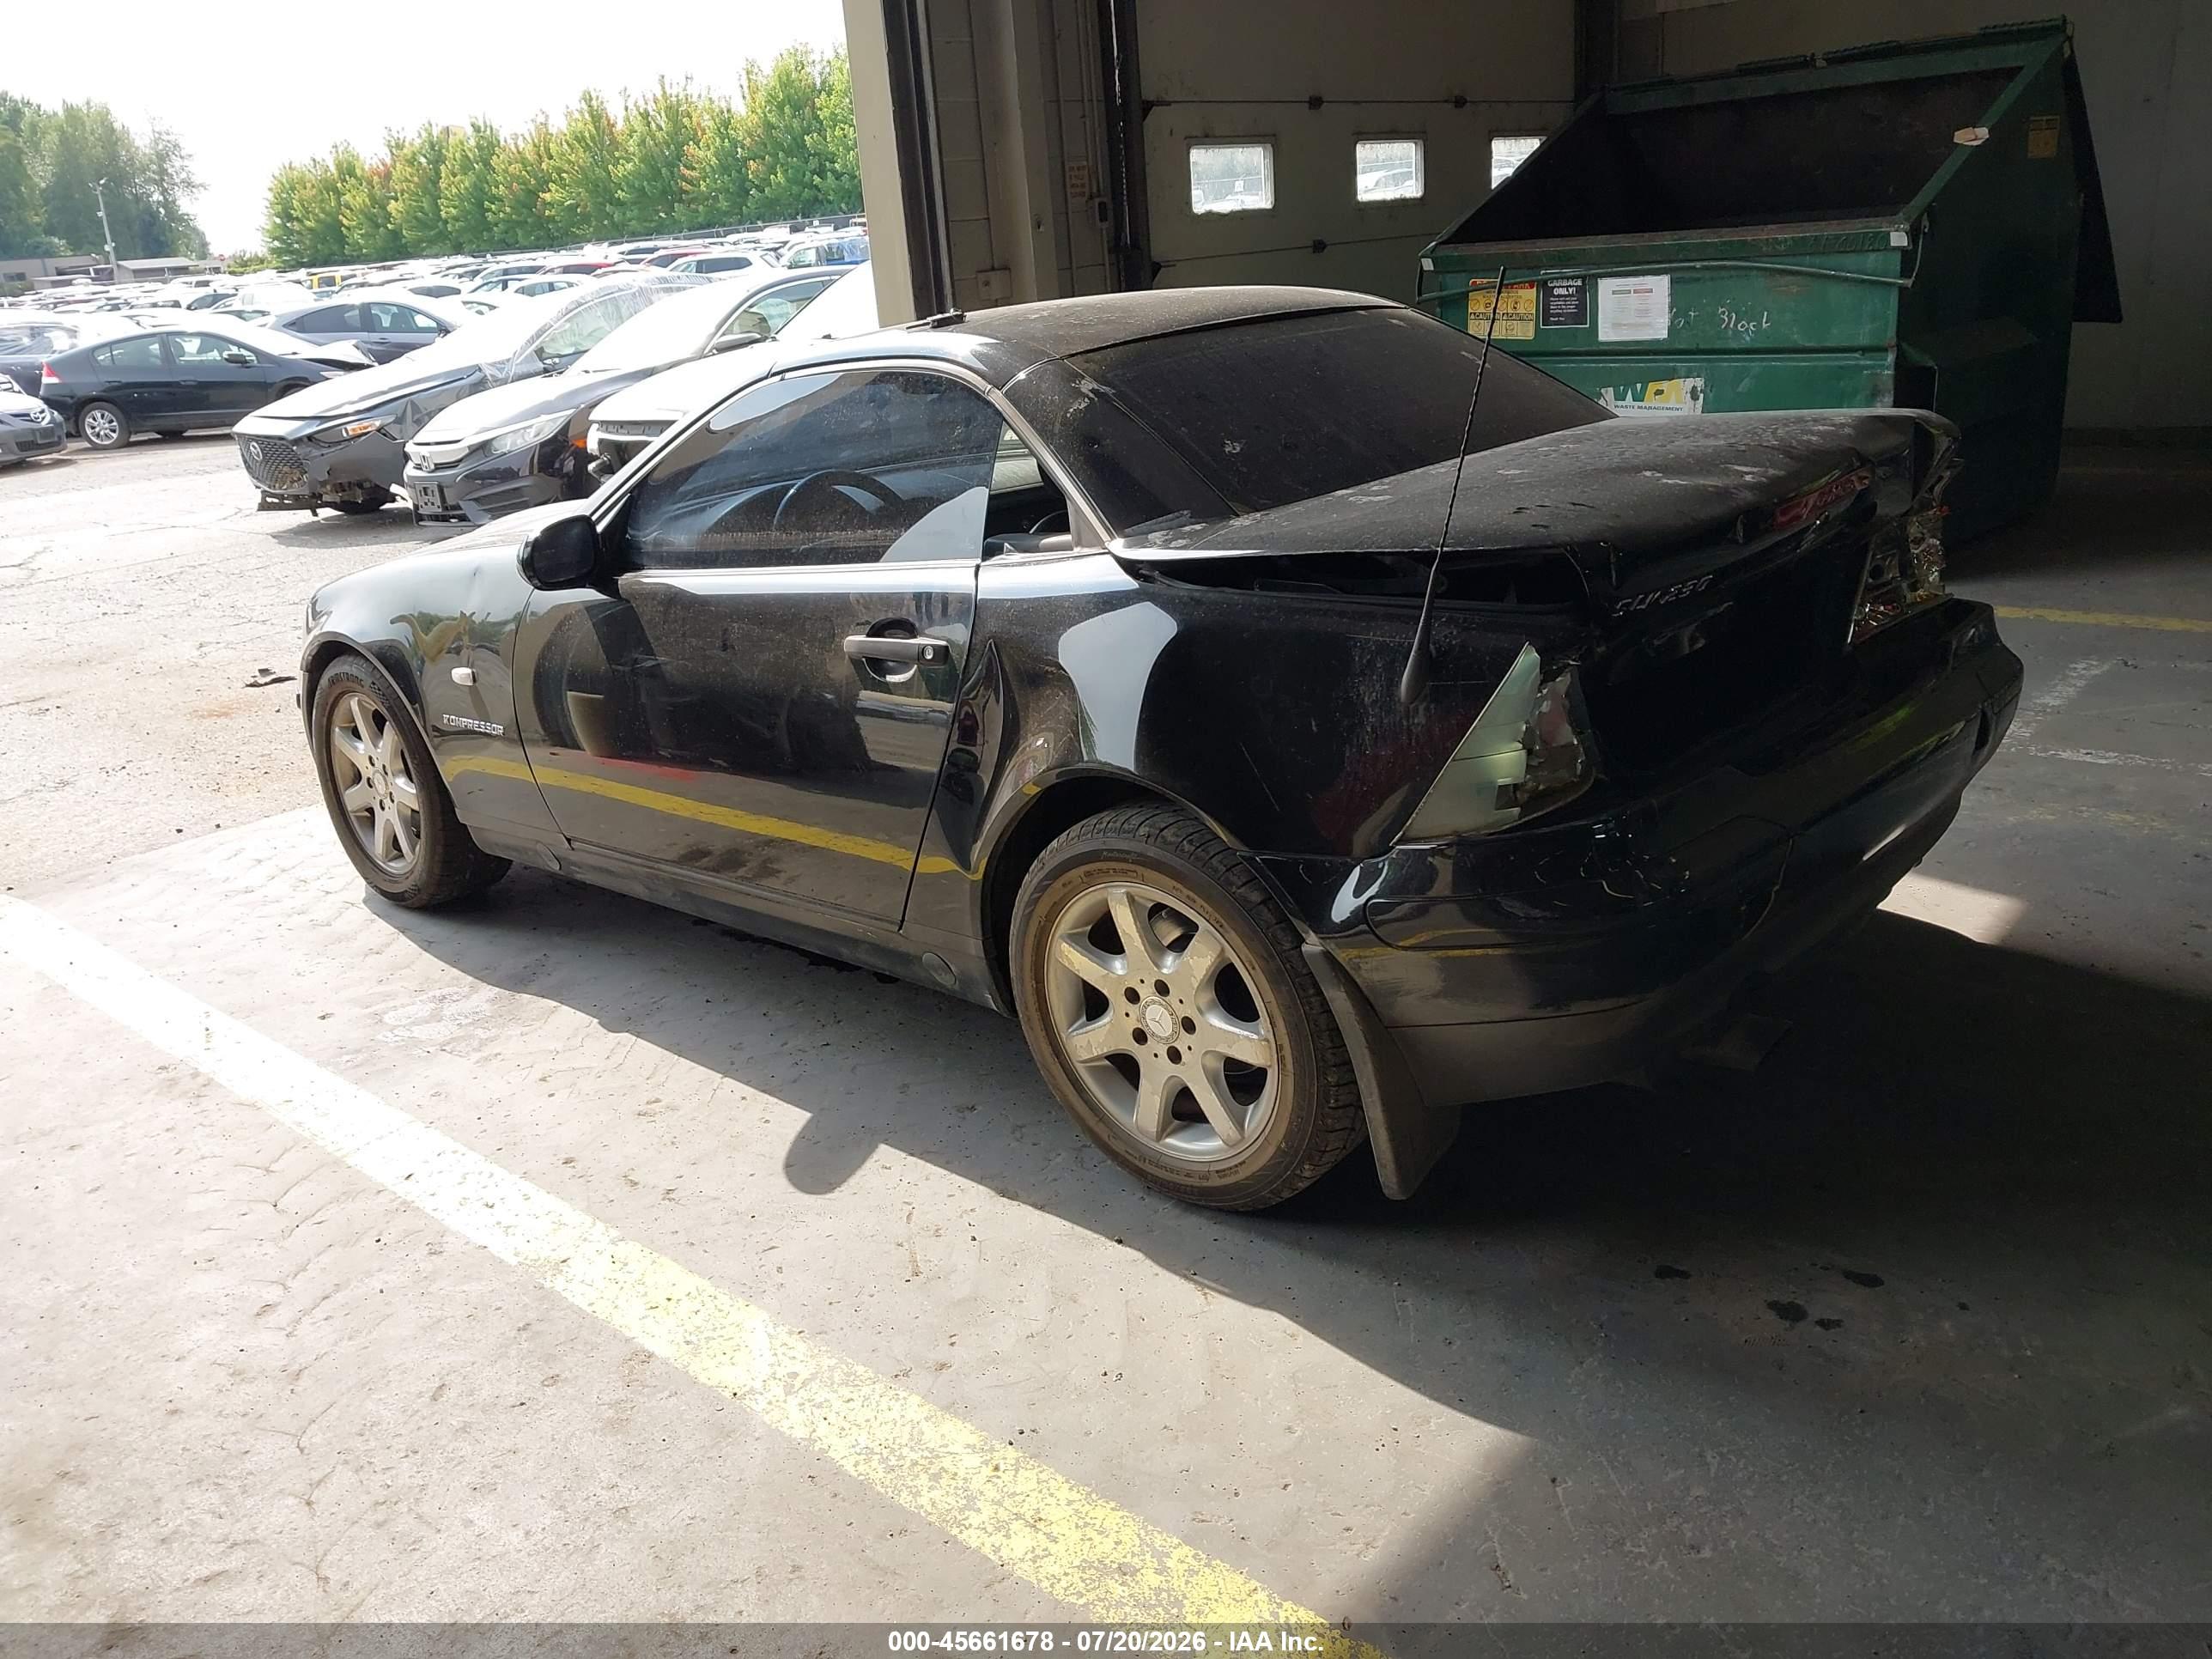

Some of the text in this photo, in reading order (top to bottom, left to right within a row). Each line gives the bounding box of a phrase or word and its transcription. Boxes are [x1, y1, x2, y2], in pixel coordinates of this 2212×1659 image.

[1547, 278, 1583, 287] GARBAGE
[1553, 287, 1577, 295] ONLY!
[442, 714, 504, 737] KOMPRESSOR
